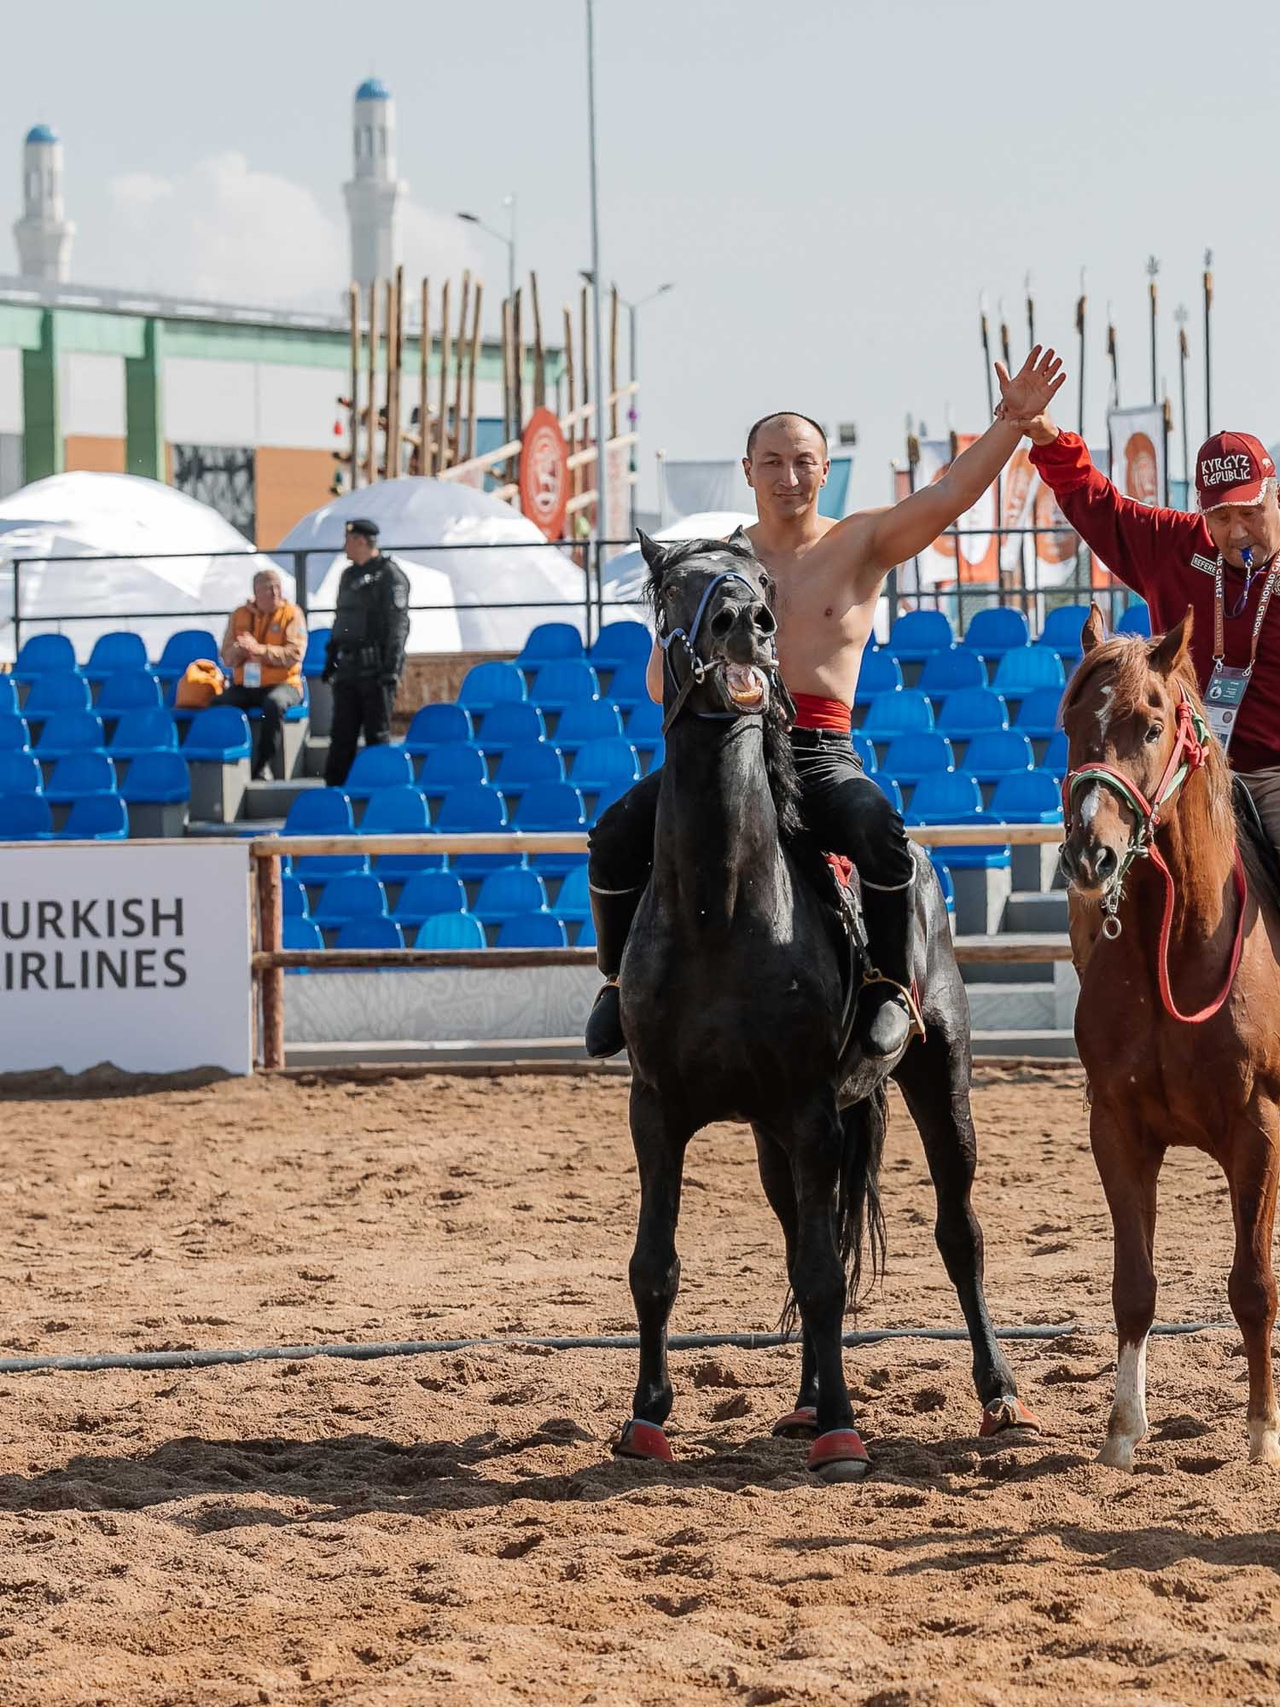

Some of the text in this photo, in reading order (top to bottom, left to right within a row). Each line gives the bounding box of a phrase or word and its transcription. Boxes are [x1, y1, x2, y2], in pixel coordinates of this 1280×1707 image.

[1201, 454, 1250, 475] KYRGYZ
[1203, 467, 1251, 487] REPUBLIC
[1252, 605, 1265, 637] WORLD
[1, 898, 184, 940] URKISH
[5, 949, 187, 990] IRLINES
